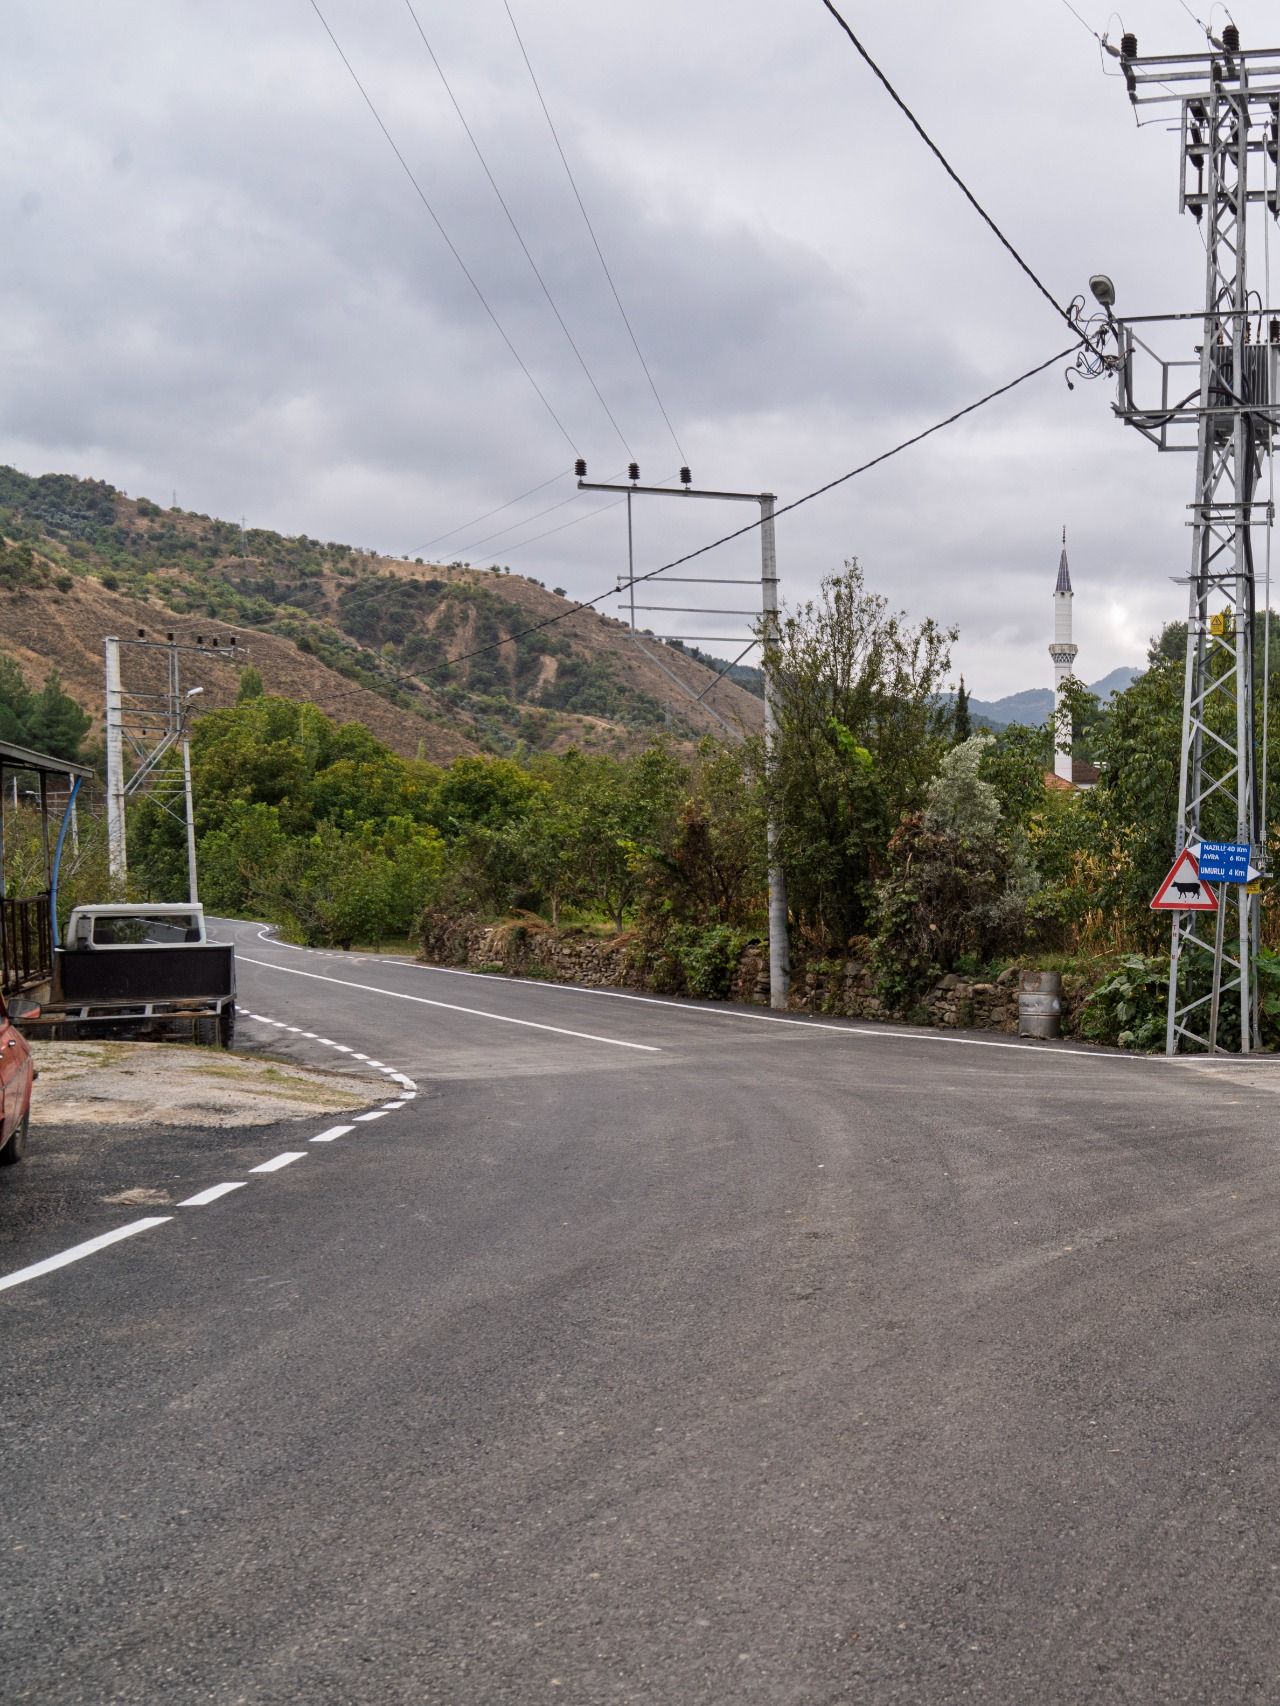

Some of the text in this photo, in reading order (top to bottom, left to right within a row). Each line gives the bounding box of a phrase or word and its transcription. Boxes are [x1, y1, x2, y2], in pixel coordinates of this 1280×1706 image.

[1200, 867, 1245, 877] UMURLU 4 Km
